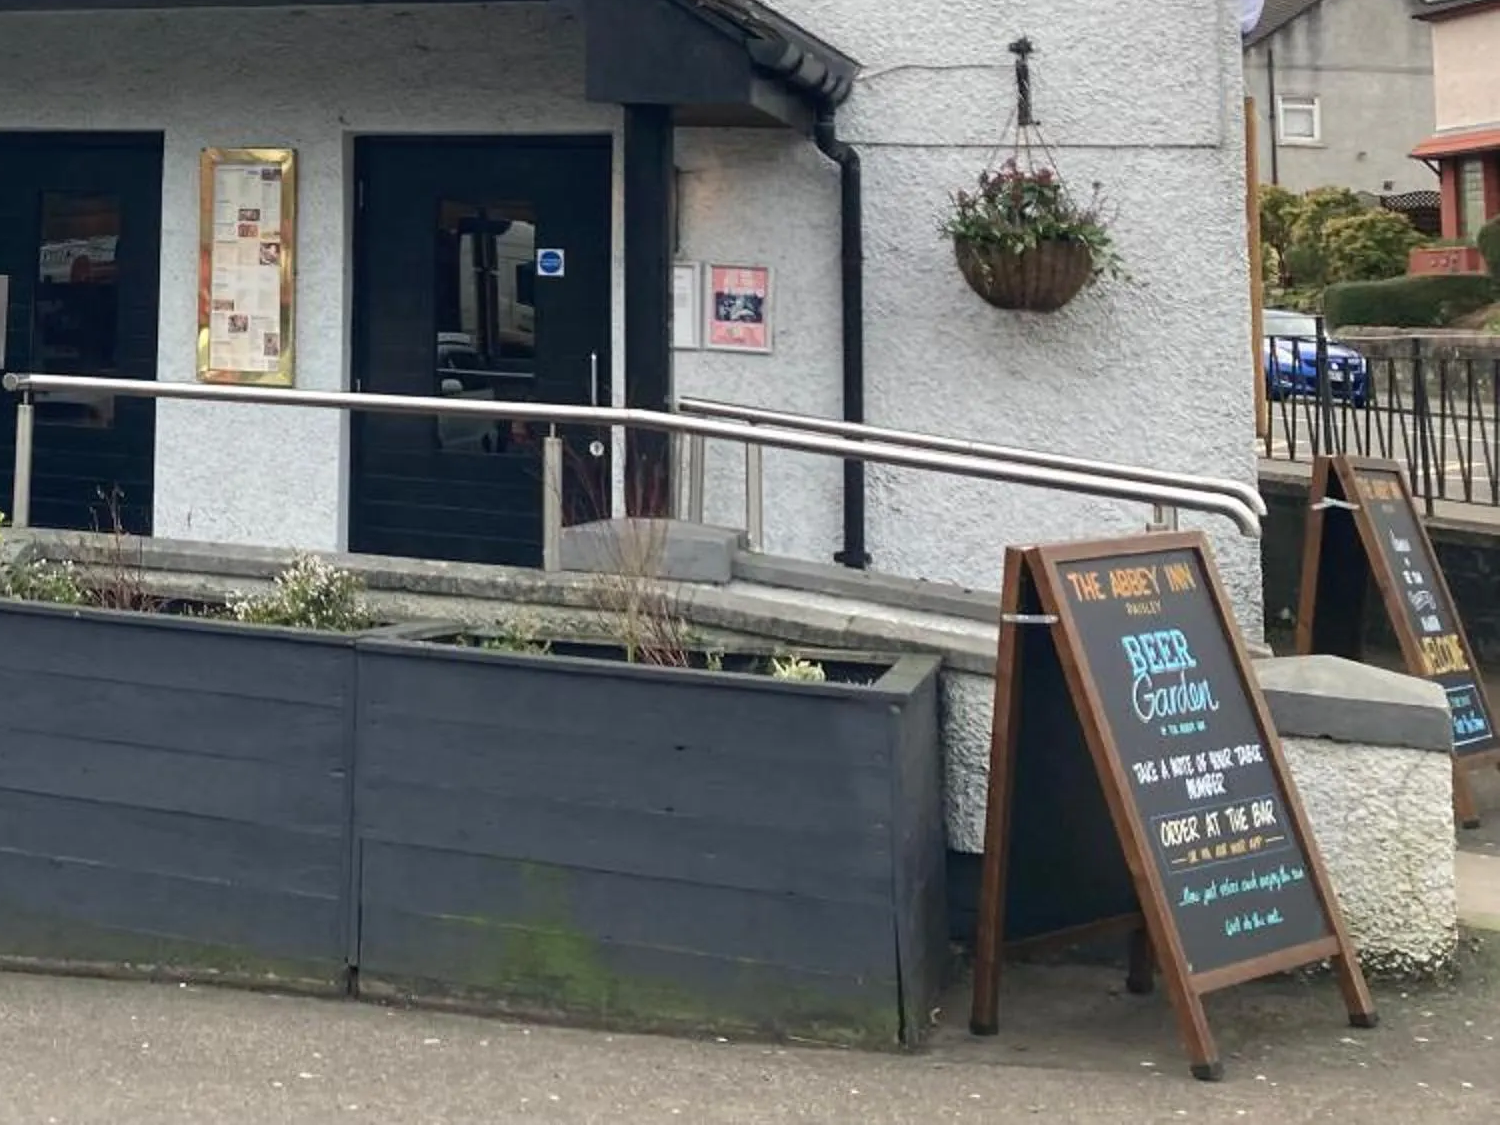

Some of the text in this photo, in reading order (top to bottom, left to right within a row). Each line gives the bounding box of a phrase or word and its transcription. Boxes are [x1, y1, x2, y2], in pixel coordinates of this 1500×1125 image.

[1066, 562, 1197, 603] THE ABBEY INN
[1121, 628, 1197, 676] BEER
[1132, 670, 1220, 724] Garden
[1160, 815, 1201, 847] ORDER
[1205, 811, 1221, 838] AT
[1224, 806, 1250, 833] THE
[1251, 800, 1277, 828] BAR
